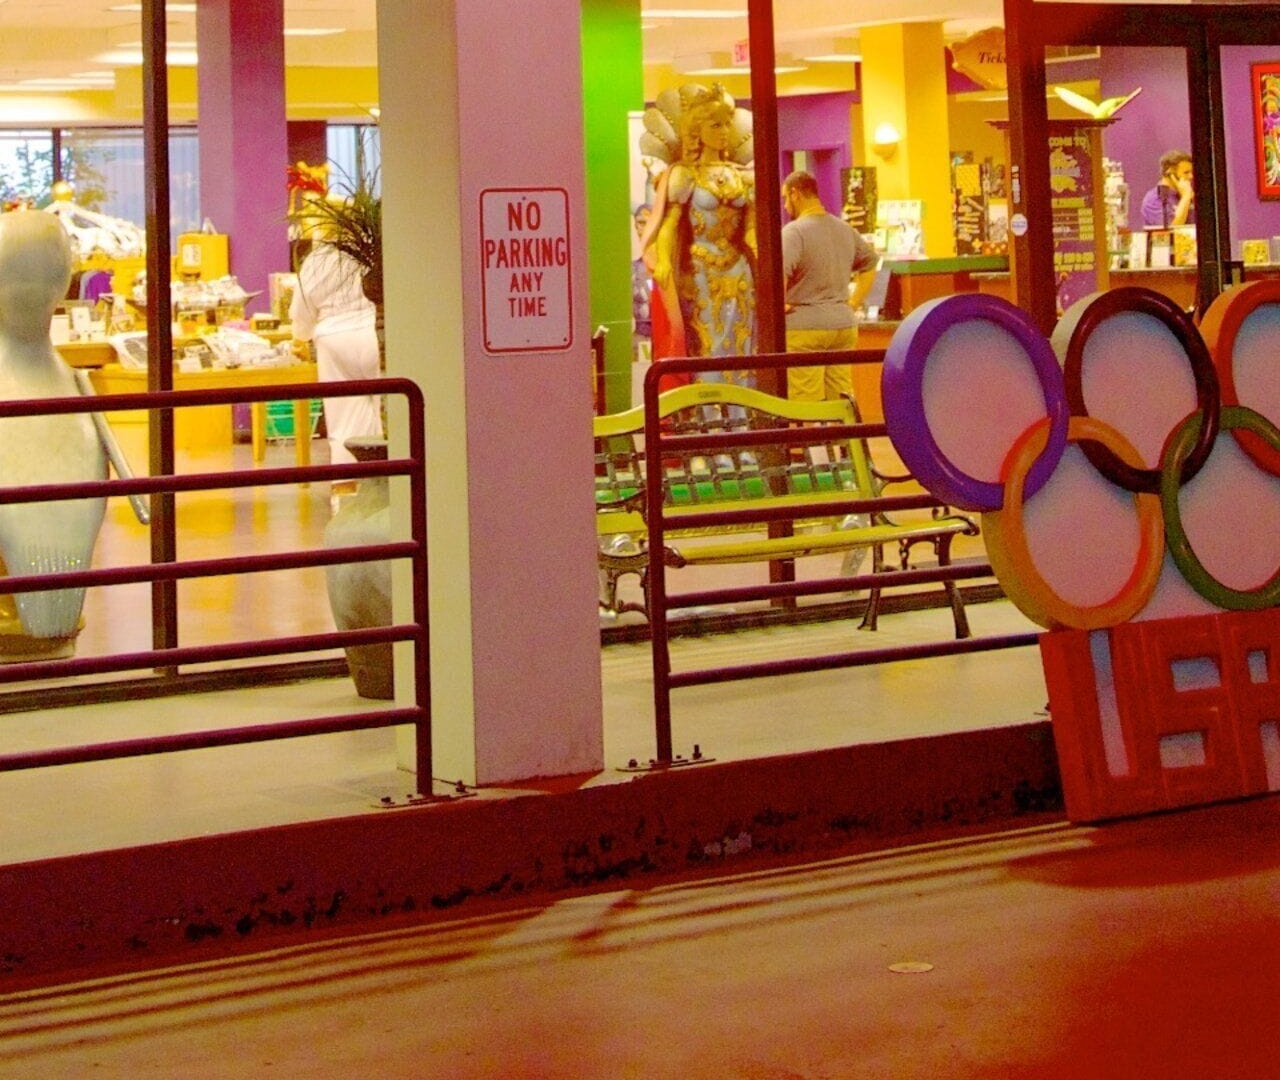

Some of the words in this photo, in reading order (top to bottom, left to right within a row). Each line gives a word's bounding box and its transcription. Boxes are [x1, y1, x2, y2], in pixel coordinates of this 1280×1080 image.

[508, 201, 541, 231] NO
[485, 237, 568, 269] PARKING
[510, 272, 543, 293] ANY
[508, 297, 547, 318] TIME
